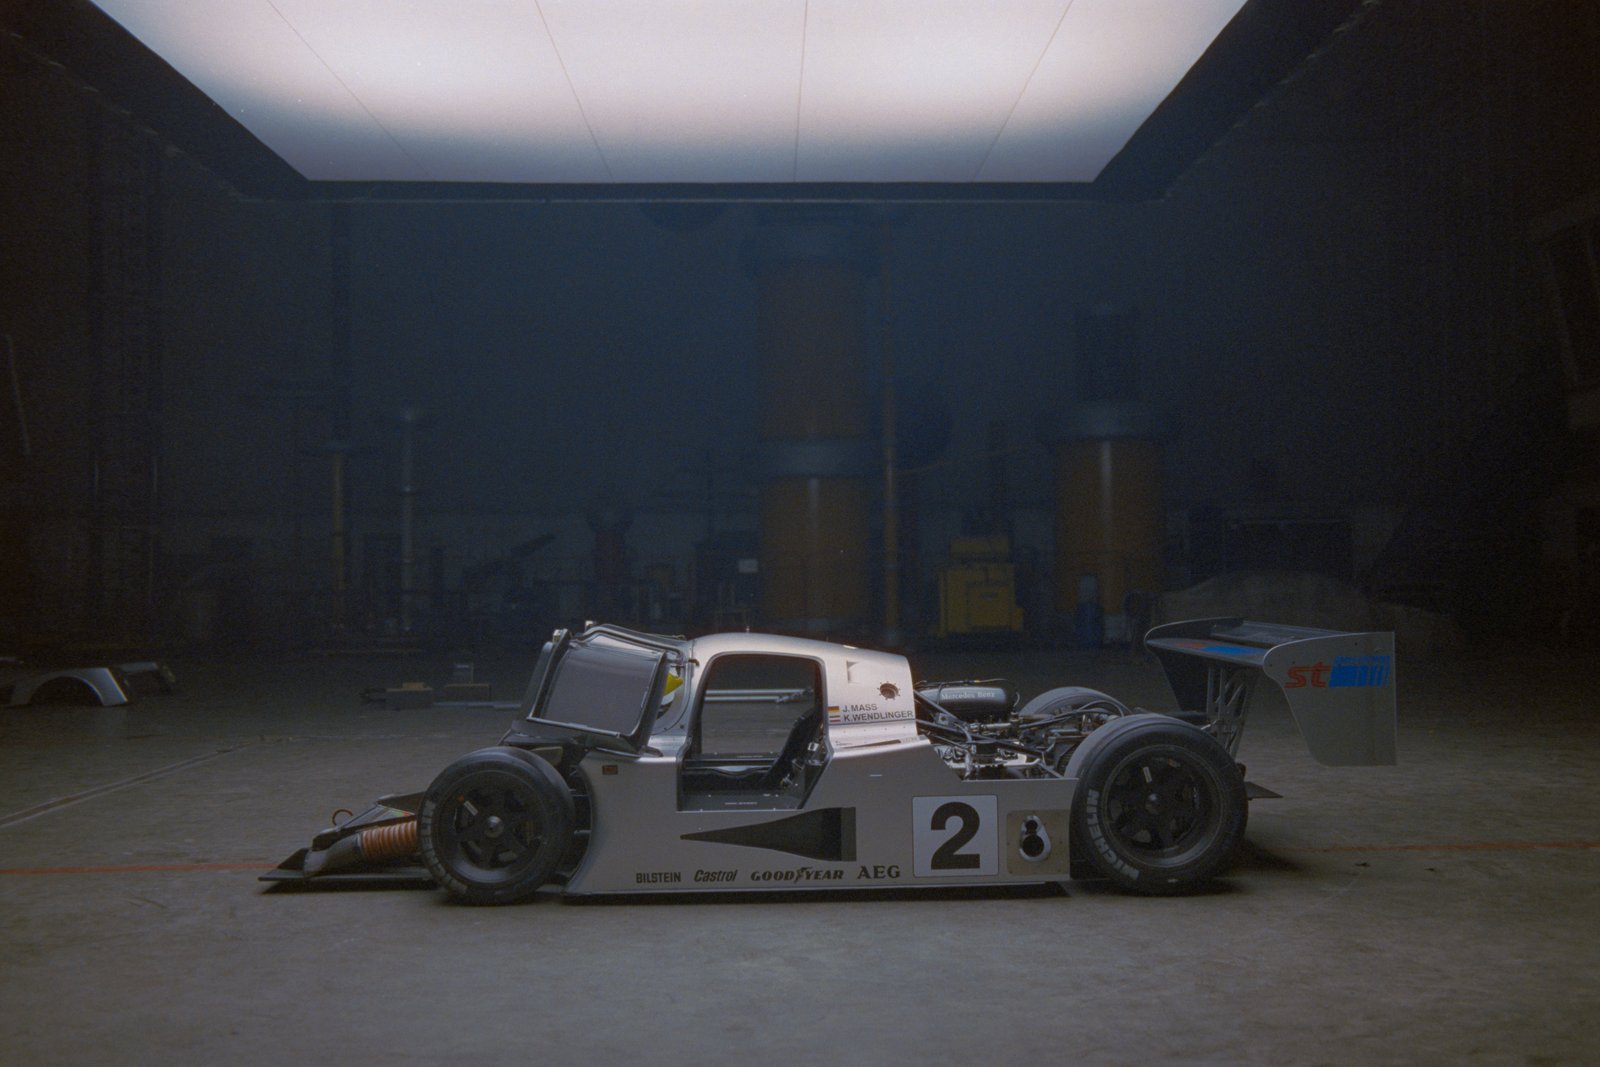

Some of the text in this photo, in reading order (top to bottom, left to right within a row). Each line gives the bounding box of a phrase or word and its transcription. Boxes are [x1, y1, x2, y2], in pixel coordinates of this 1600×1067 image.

[842, 703, 878, 713] J. MASS
[852, 710, 914, 721] WENDLINGER
[931, 802, 980, 870] 2
[635, 871, 681, 884] BILSTEIN
[693, 868, 738, 883] Castrol
[750, 865, 844, 884] GOODYEAR
[856, 864, 901, 879] AEG
